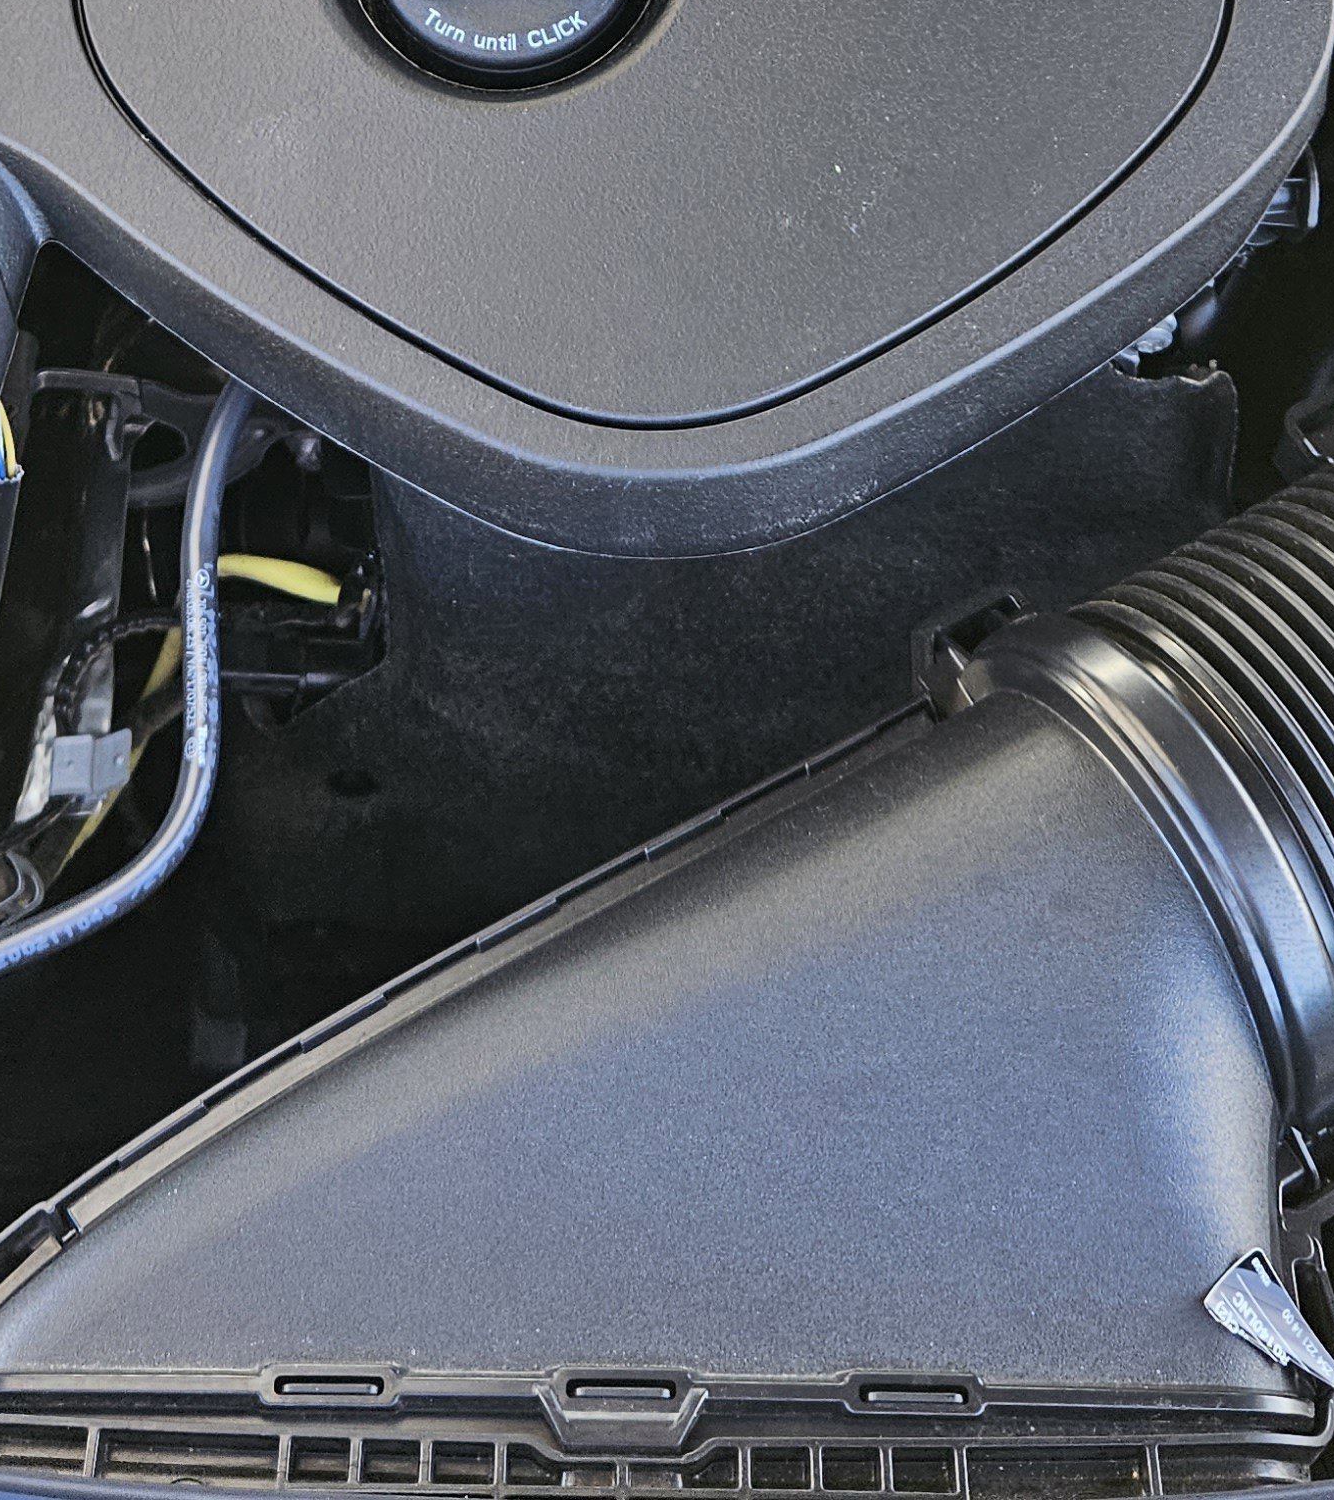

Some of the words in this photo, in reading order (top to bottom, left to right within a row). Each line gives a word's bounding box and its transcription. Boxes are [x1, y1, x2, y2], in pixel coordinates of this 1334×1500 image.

[424, 7, 466, 44] Turn
[473, 33, 518, 51] until
[526, 10, 588, 49] CLICK
